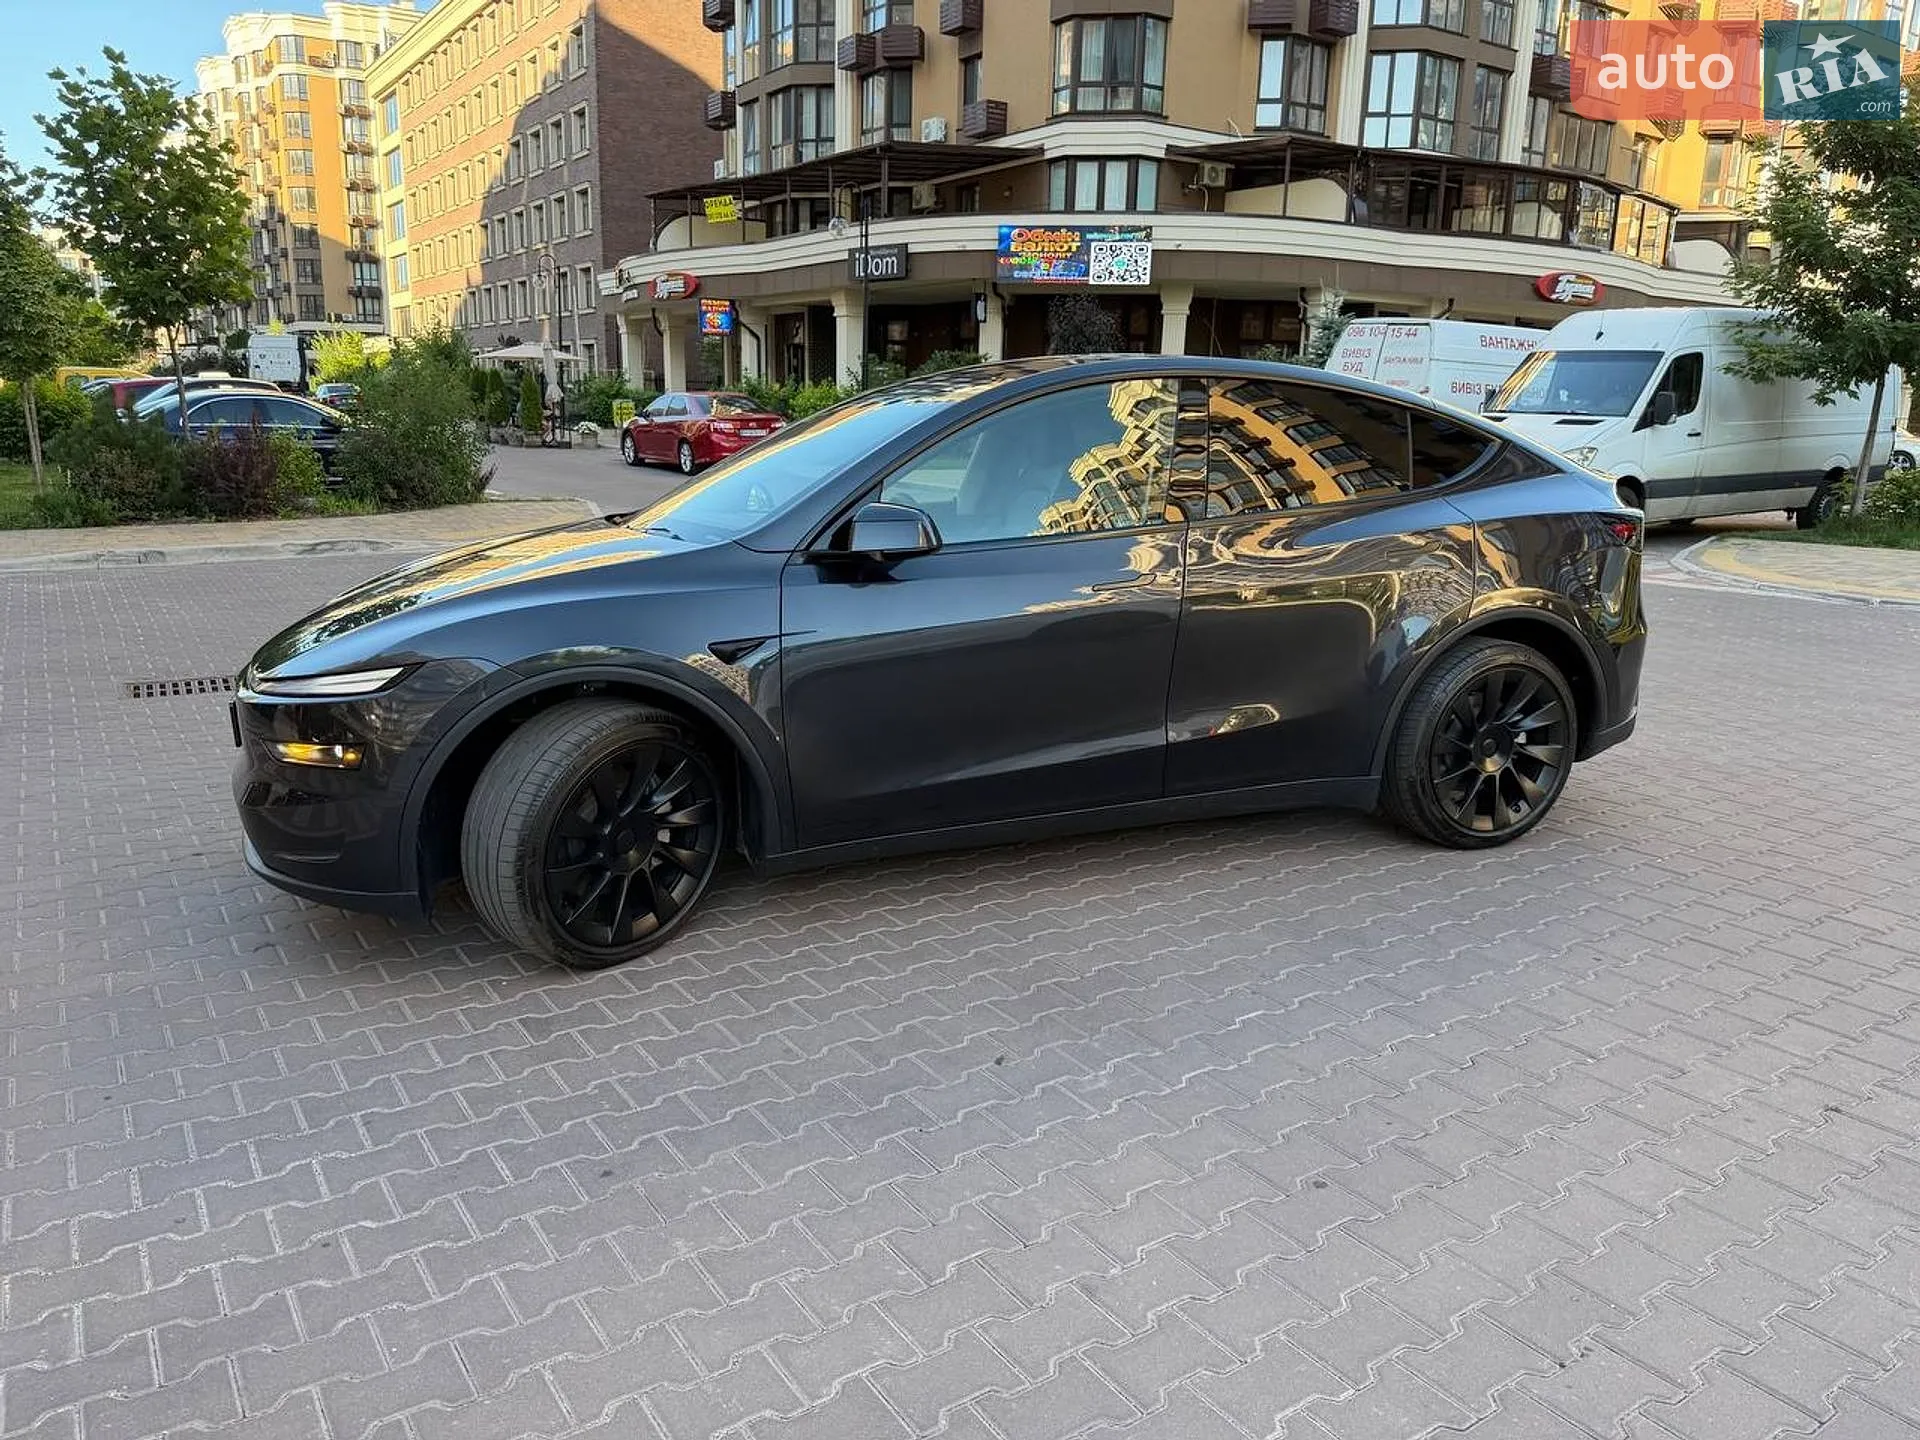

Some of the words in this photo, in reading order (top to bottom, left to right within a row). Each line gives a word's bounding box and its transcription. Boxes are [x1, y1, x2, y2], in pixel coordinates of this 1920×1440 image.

[1391, 327, 1403, 338] 15
[1405, 326, 1418, 337] 44
[1480, 334, 1538, 351] ВАНТАЖН
